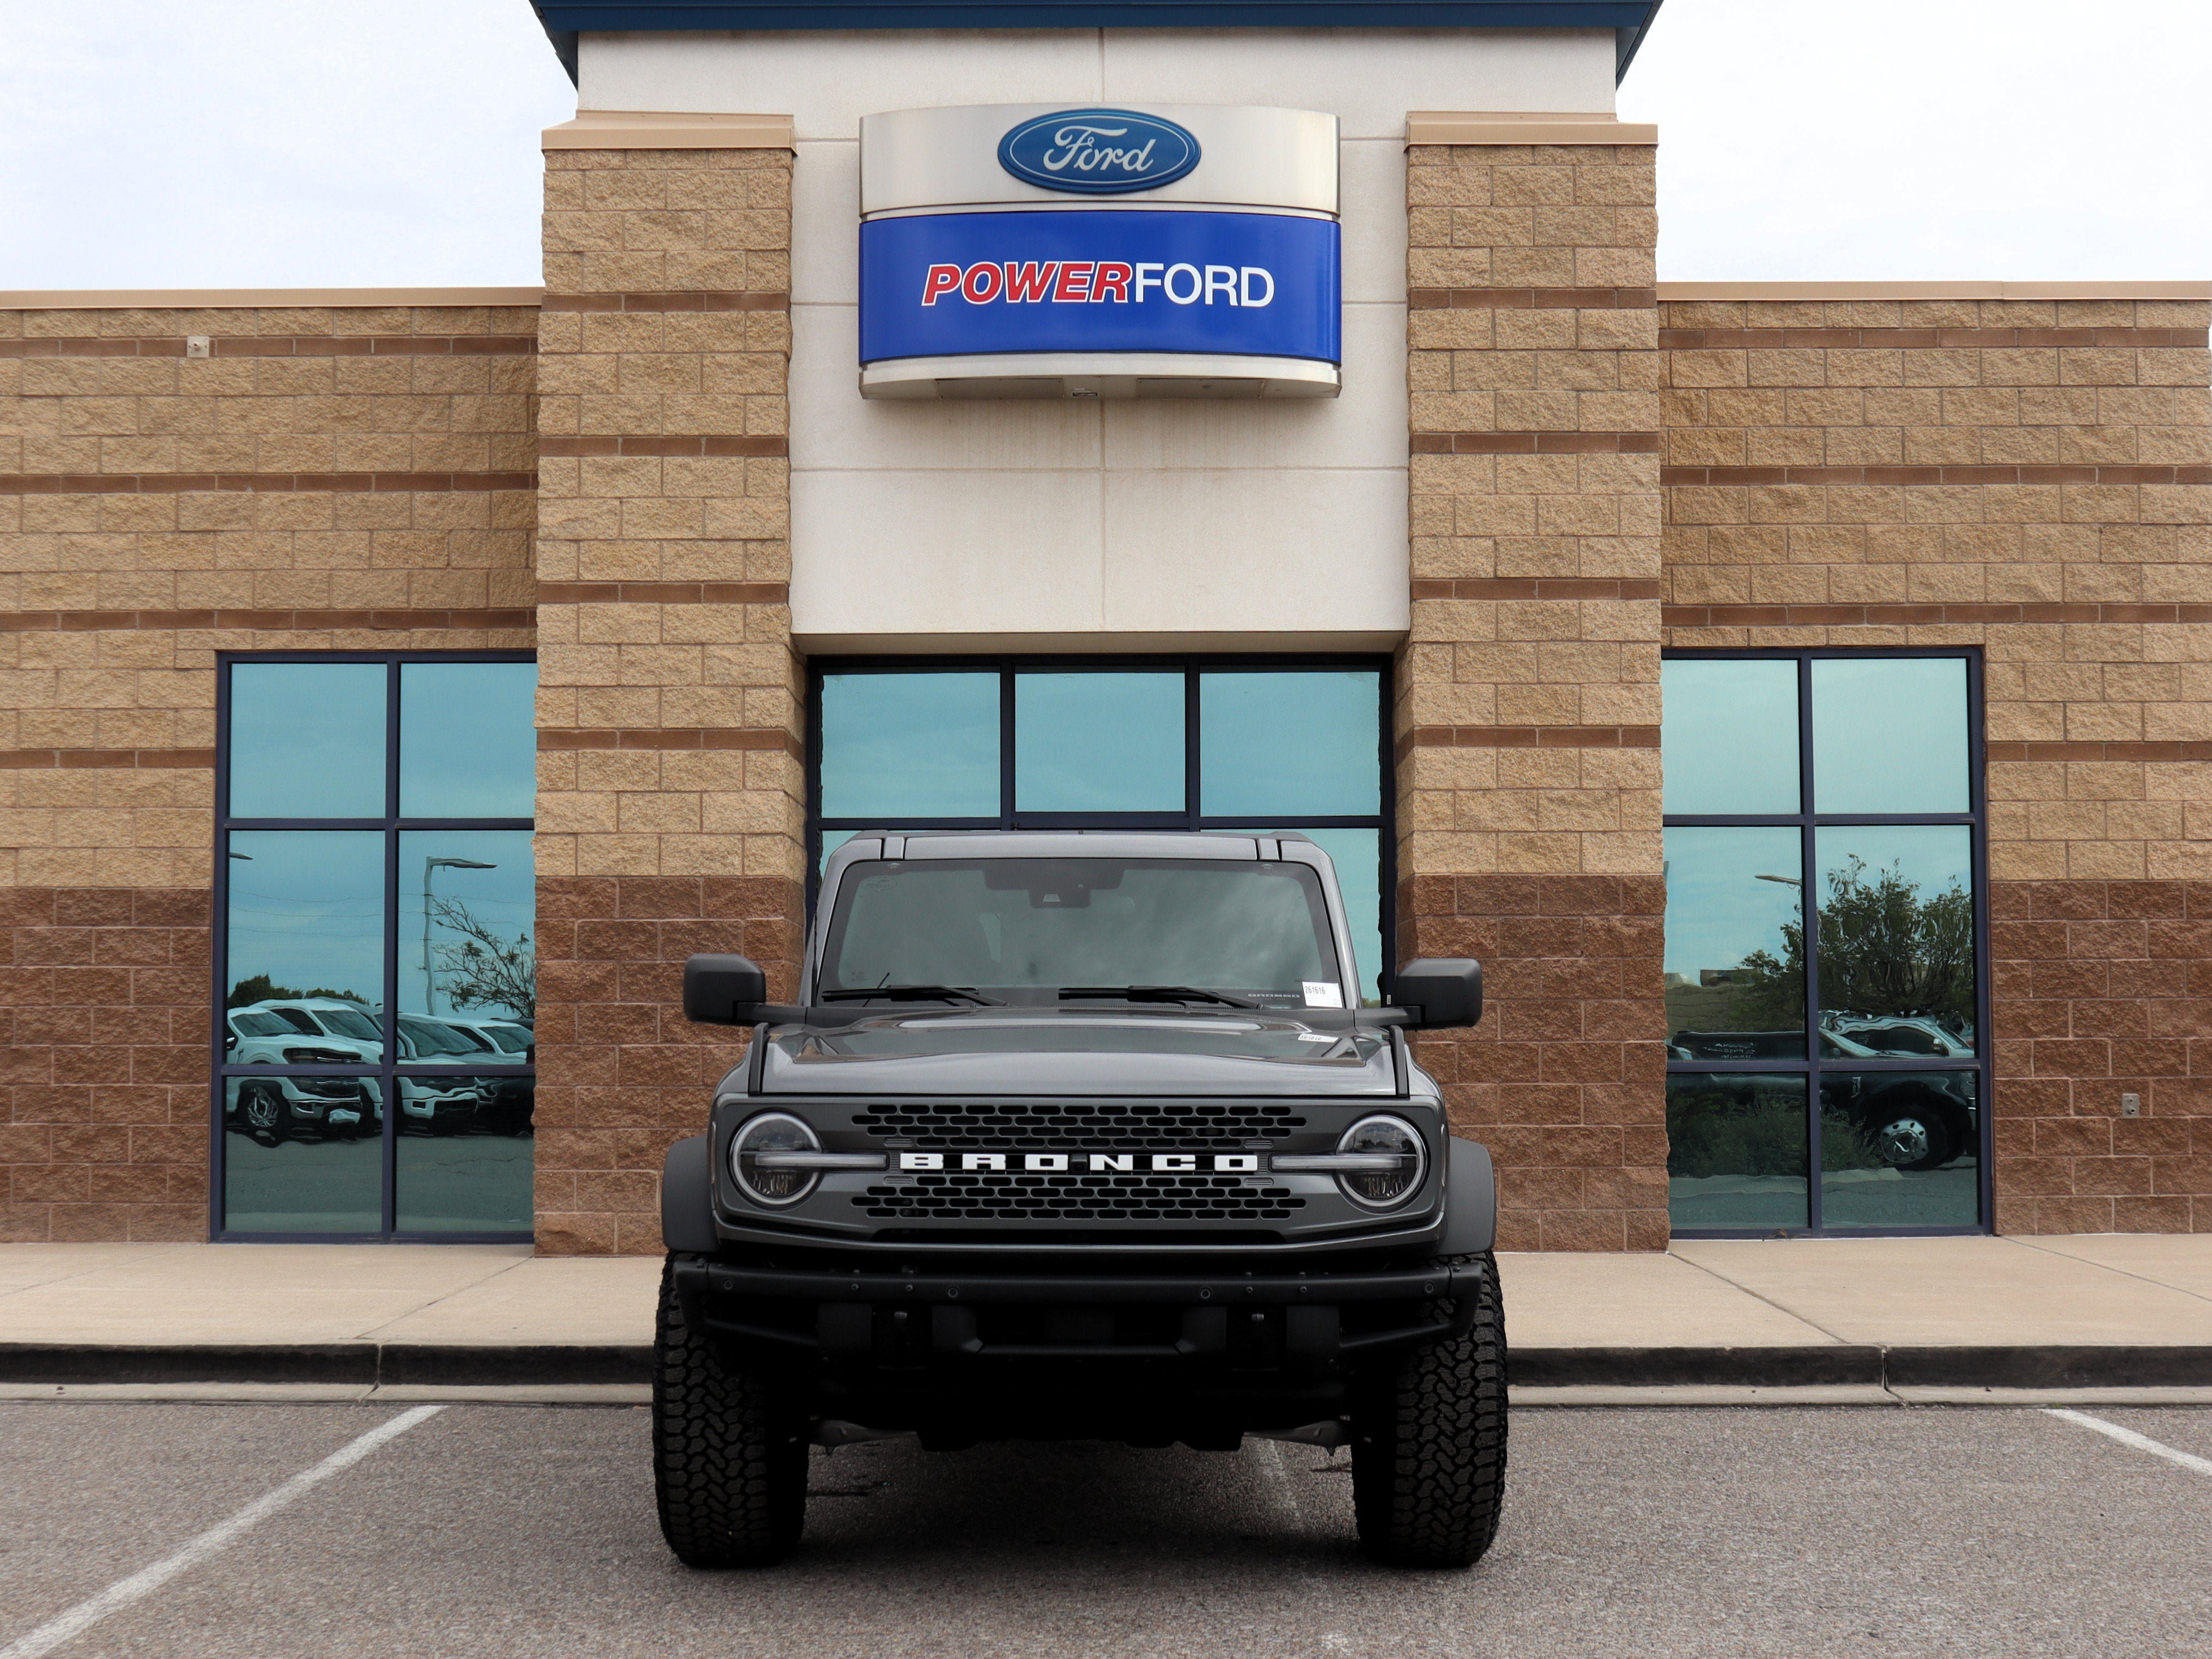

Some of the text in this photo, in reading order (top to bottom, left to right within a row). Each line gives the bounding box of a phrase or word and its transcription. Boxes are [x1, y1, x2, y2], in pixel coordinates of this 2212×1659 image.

[1043, 125, 1156, 171] Ford
[1305, 986, 1325, 995] 261616
[900, 1153, 1258, 1171] BRONCO
